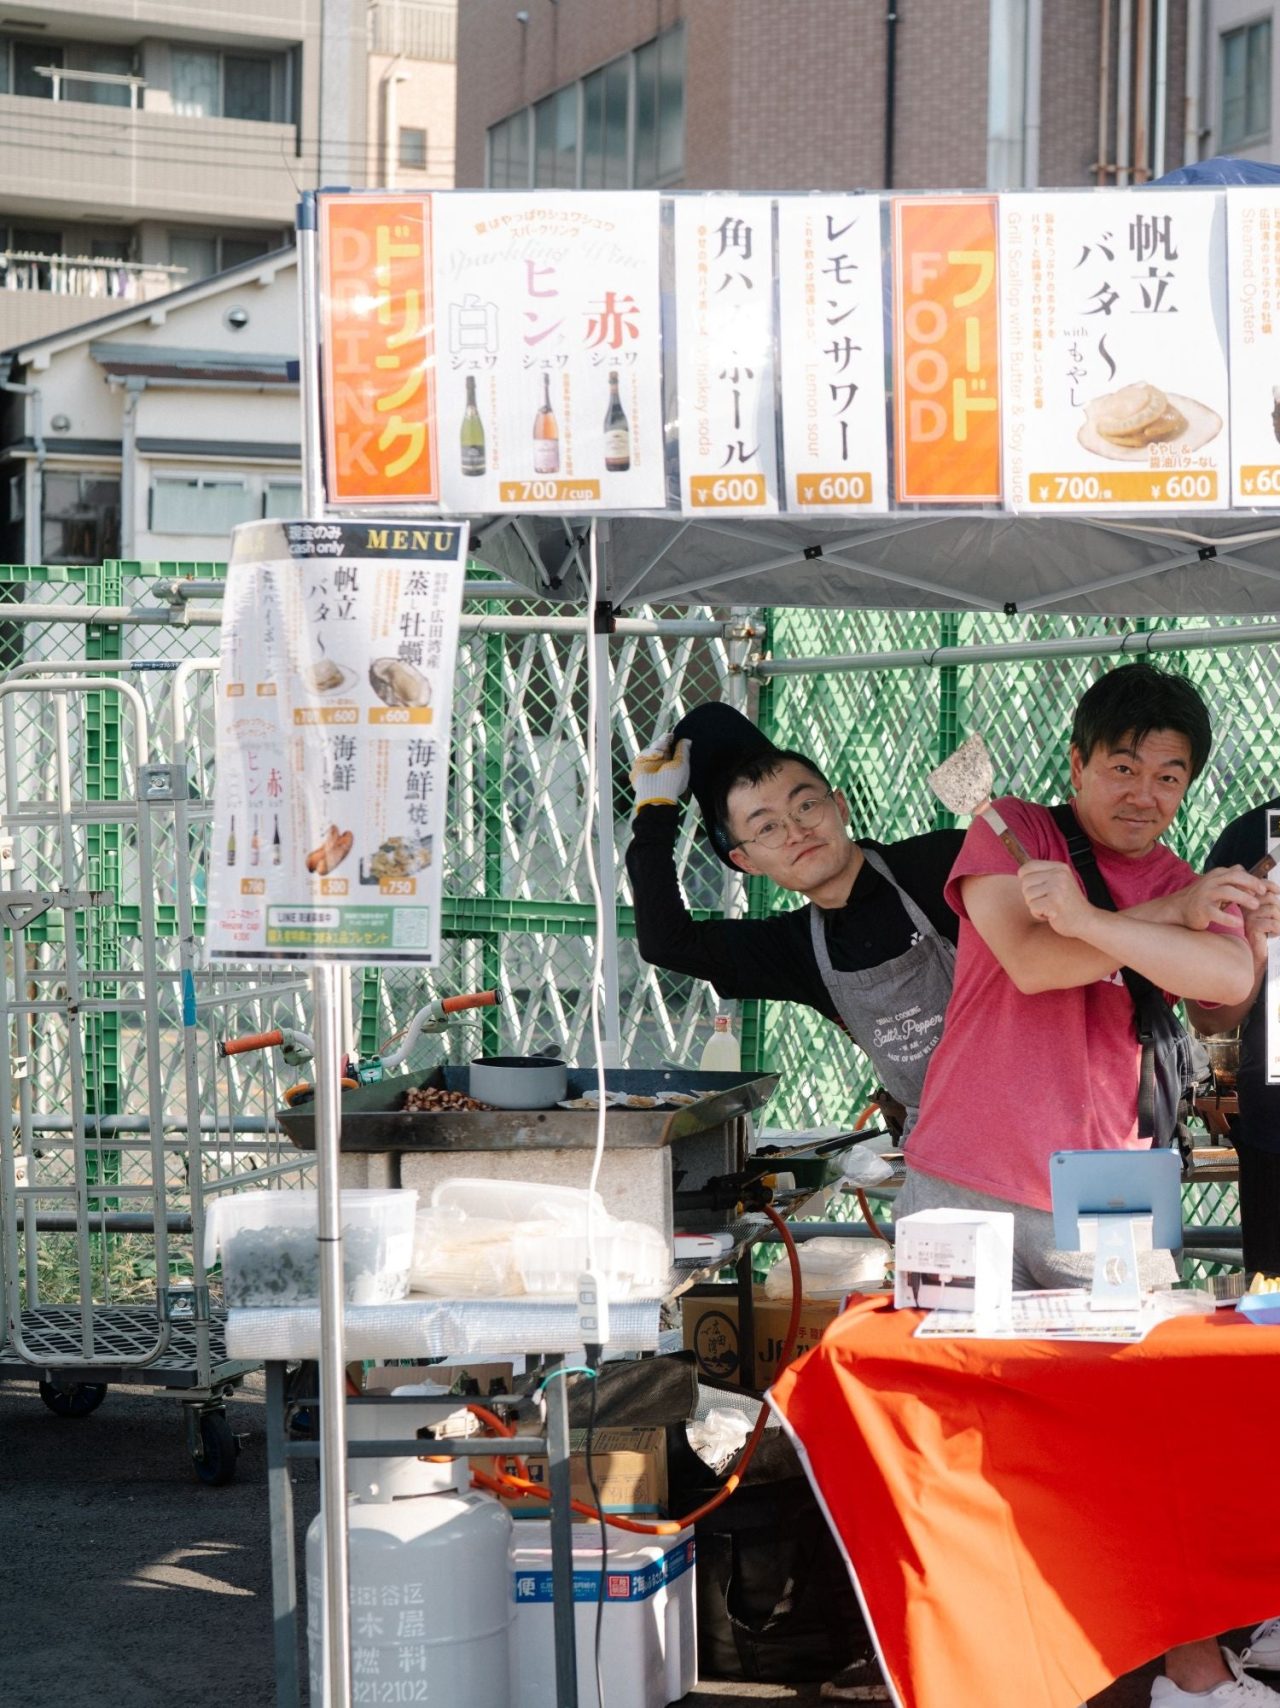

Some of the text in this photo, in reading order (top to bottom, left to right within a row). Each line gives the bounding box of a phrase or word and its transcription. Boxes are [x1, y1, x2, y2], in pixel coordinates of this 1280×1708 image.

[1006, 249, 1023, 307] Scallop
[1128, 213, 1179, 315] 帆立
[448, 293, 500, 354] 白
[582, 290, 641, 351] 赤
[714, 216, 760, 469] 角ハール
[822, 214, 862, 461] レモンサワー
[1009, 312, 1024, 345] with
[1063, 326, 1089, 338] with
[332, 227, 379, 477] DRINK
[375, 225, 426, 479] ドリンク
[450, 353, 499, 371] シュワ
[522, 353, 570, 370] シュワ
[591, 351, 639, 368] シュワ
[905, 252, 948, 443] FOOD
[948, 250, 997, 442] フード
[1010, 351, 1024, 399] Butter
[1066, 341, 1087, 408] もやし
[1009, 423, 1025, 452] Soy
[1149, 443, 1178, 456] もやし
[1011, 457, 1024, 504] sauce
[317, 541, 345, 556] only
[366, 529, 455, 551] MENU
[333, 566, 359, 621] 帆立
[331, 734, 358, 792] 海鮮
[901, 1014, 943, 1041] Pepper
[350, 1582, 425, 1606] 田谷区
[517, 1577, 536, 1597] 便
